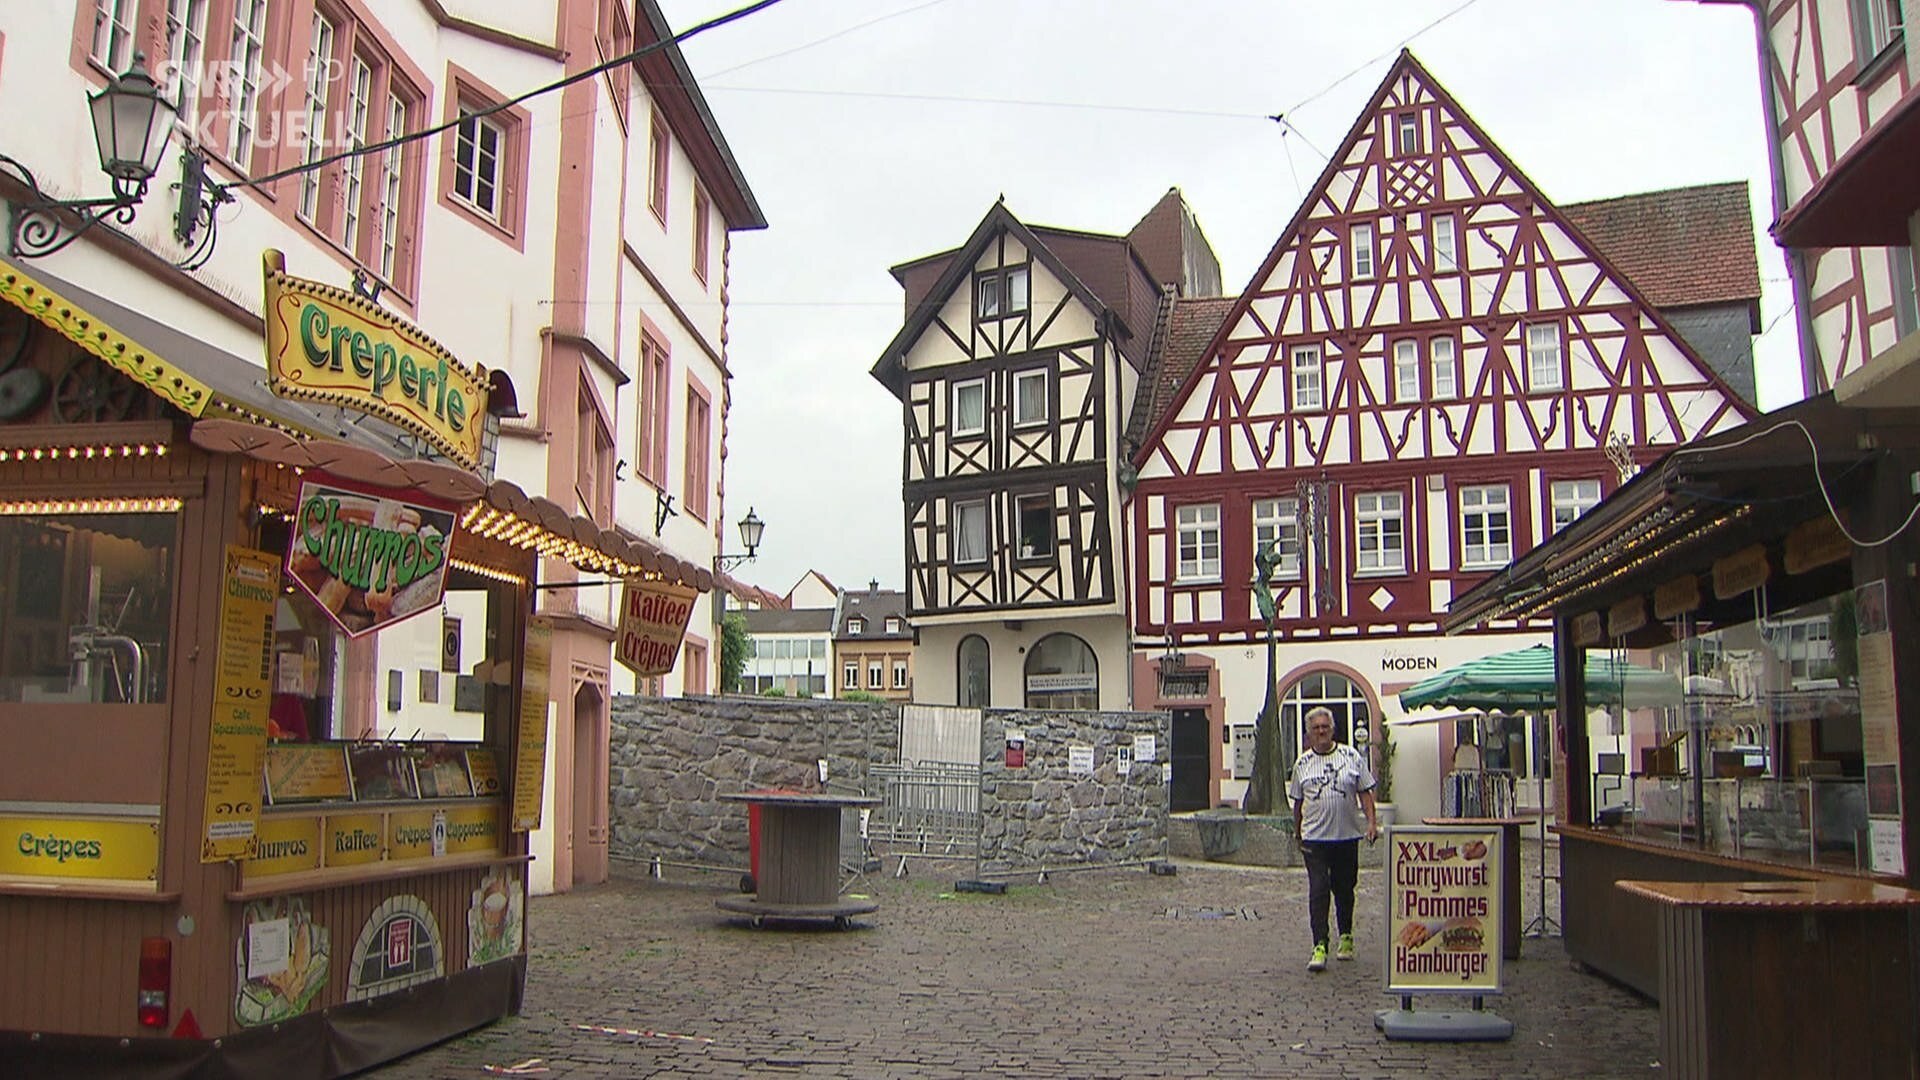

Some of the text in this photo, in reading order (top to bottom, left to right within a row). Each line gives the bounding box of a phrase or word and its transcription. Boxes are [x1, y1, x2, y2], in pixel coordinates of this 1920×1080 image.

[300, 303, 467, 432] Creperie
[303, 495, 445, 593] Churros
[228, 577, 273, 602] Churros
[630, 589, 687, 626] Kaffee
[623, 631, 675, 671] Crêpes
[1382, 657, 1437, 671] MODEN
[253, 837, 308, 861] hurros
[335, 829, 378, 852] Kaffee
[1397, 841, 1440, 862] XXL
[1396, 861, 1488, 892] Currywurst
[1404, 890, 1488, 918] Pommes
[1396, 946, 1488, 980] Hamburger
